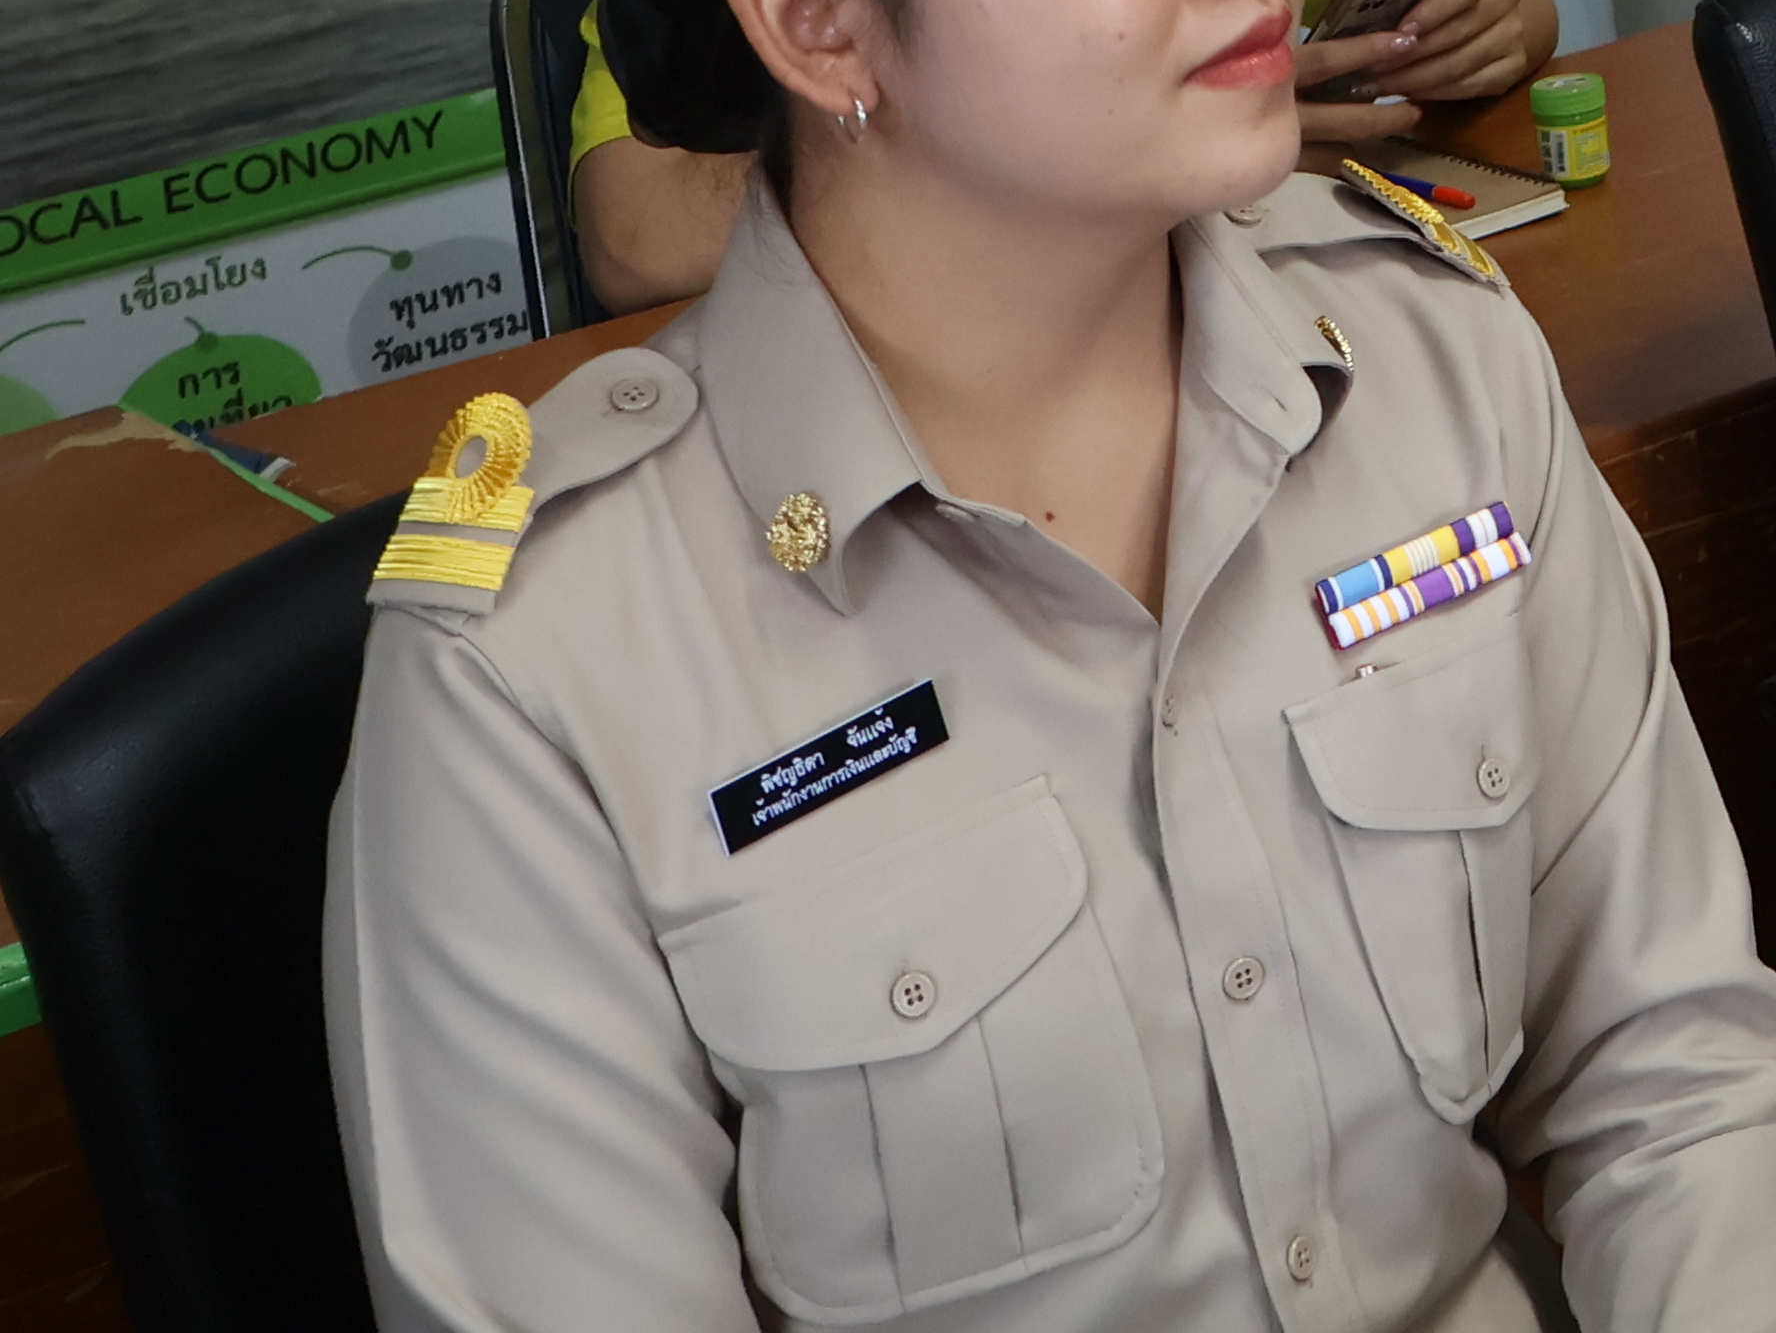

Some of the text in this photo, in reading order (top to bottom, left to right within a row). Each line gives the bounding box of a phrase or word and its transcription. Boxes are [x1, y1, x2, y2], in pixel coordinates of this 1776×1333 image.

[163, 109, 444, 215] ECONOMY
[119, 256, 268, 316] เชื่อมโยง
[389, 268, 504, 330] ทุนทาง
[371, 307, 530, 374] วัฒนธรรม
[177, 360, 240, 400] การ
